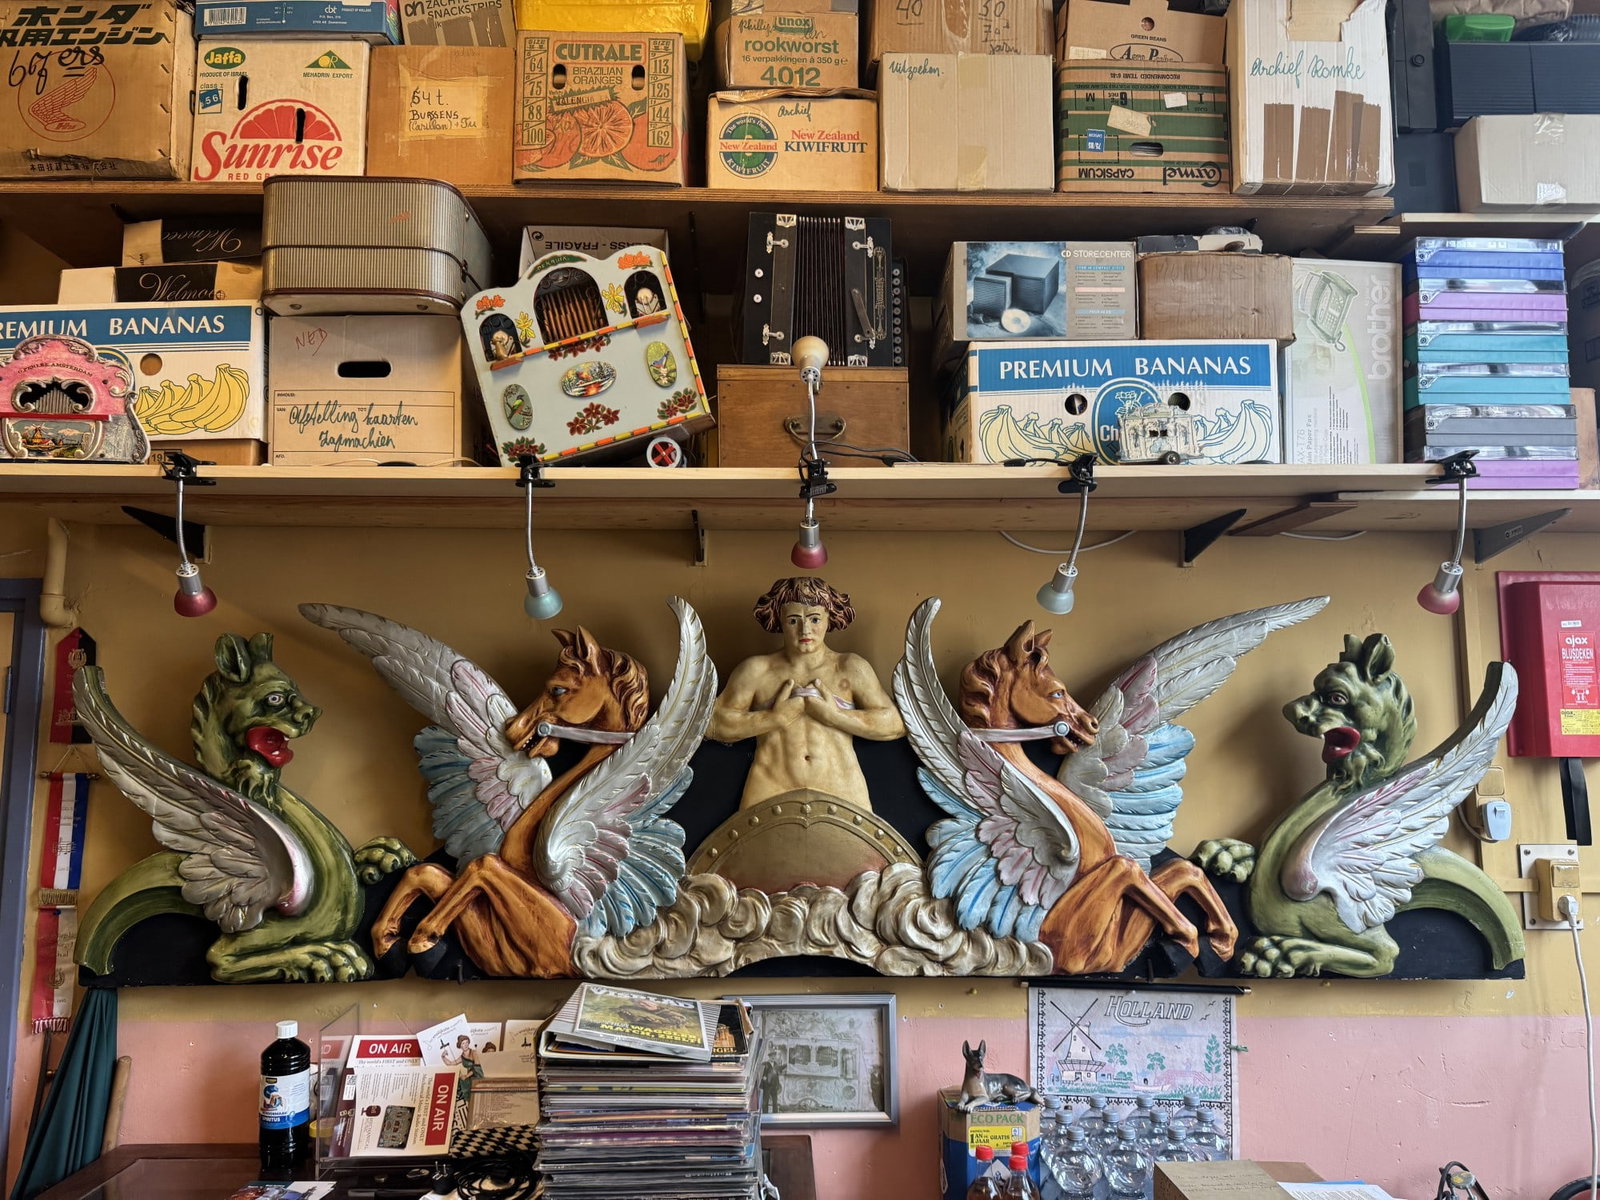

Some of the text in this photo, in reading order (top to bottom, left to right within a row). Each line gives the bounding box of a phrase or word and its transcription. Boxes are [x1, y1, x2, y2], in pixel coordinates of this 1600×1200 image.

[12, 4, 152, 26] ホンダ
[324, 5, 337, 14] cbt
[777, 16, 811, 27] unox
[555, 44, 643, 62] CUTRALE
[744, 37, 839, 54] rookworst
[205, 51, 242, 65] Jaffa
[530, 57, 543, 73] 64
[653, 58, 669, 74] 113
[752, 56, 808, 64] verpakkingen
[817, 56, 832, 64] 350
[572, 66, 623, 76] BRAZILIAN
[760, 65, 821, 86] 4012
[530, 80, 542, 96] 75
[573, 76, 623, 85] ORANGES
[651, 82, 670, 98] 125
[1086, 92, 1096, 102] M
[1120, 92, 1128, 105] 6
[528, 105, 542, 121] 88
[652, 106, 670, 122] 144
[526, 128, 544, 144] 100
[652, 130, 670, 146] 162
[791, 130, 860, 140] New Zealand
[720, 141, 778, 150] New Zealand
[784, 141, 868, 154] KIWIFRUIT
[194, 131, 343, 182] Sunrise
[727, 158, 770, 174] KIWIFRUIT
[1078, 168, 1134, 178] CAPSICUM
[1163, 162, 1222, 188] Carmel
[545, 241, 599, 250] FRAGILE
[110, 316, 225, 336] BANANAS
[1367, 274, 1392, 380] brother
[295, 328, 328, 356] NED
[1000, 356, 1252, 380] PREMIUM BANANAS
[1565, 635, 1588, 648] ajax
[1561, 648, 1594, 660] BLUSDEKEN
[1104, 996, 1195, 1025] HOLLAND
[368, 1042, 412, 1054] ON AIR
[432, 1084, 450, 1132] ON AIR
[970, 1114, 1024, 1124] ECO PACK
